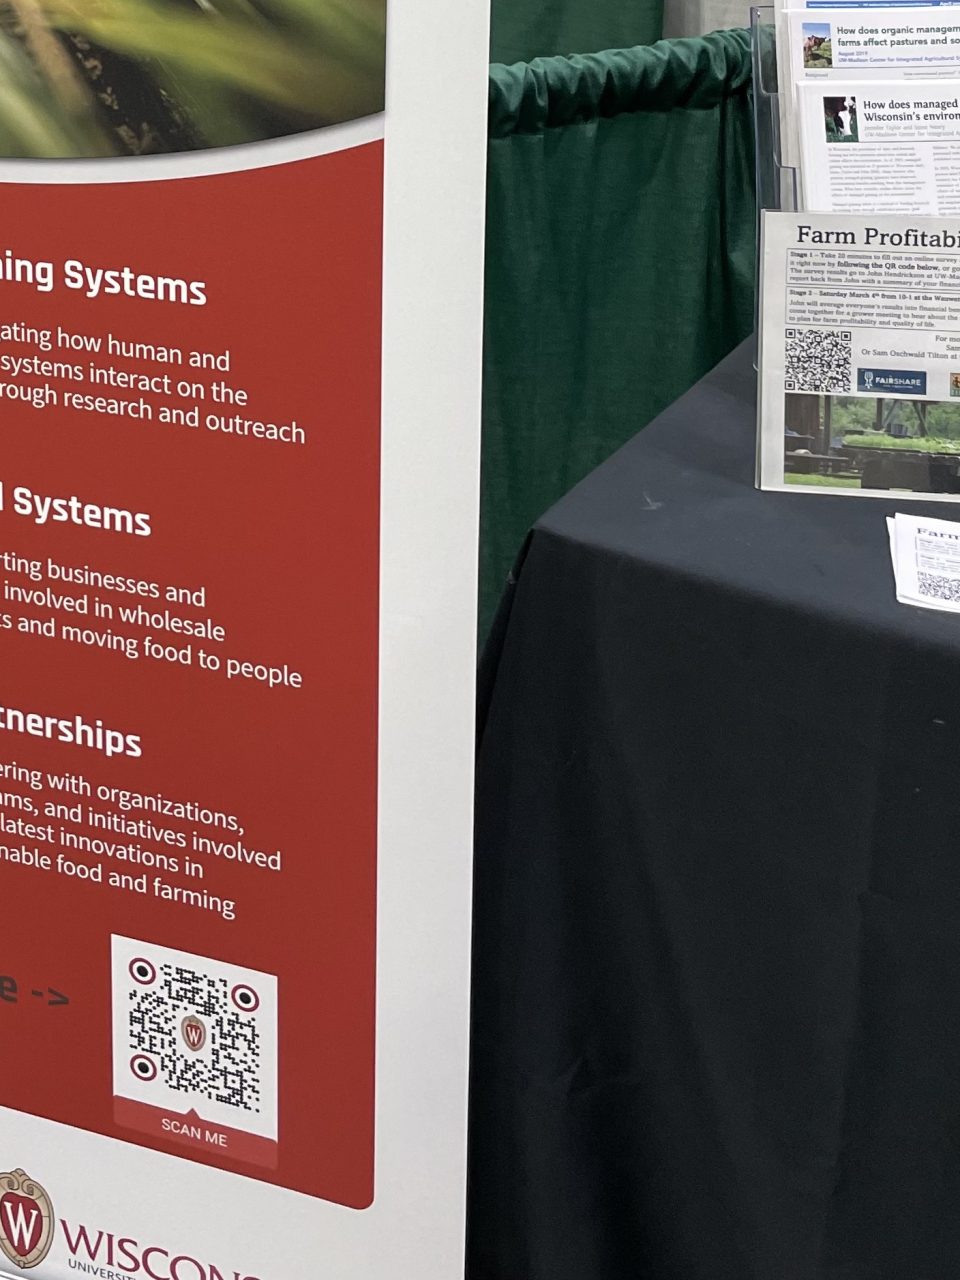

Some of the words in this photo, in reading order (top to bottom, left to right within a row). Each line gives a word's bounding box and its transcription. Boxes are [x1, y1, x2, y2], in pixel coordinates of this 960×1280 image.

[838, 38, 860, 46] farms
[863, 37, 887, 46] affect
[890, 38, 927, 47] pastures
[858, 26, 878, 34] does
[882, 26, 914, 35] organic
[864, 101, 885, 109] How
[889, 100, 910, 109] does
[914, 98, 958, 111] managed
[797, 226, 856, 244] Farm
[64, 260, 207, 305] Systems
[838, 261, 869, 269] following
[57, 327, 101, 353] how
[108, 334, 182, 364] human
[189, 350, 230, 371] and
[890, 350, 925, 358] Oschwald
[950, 352, 957, 360] at
[0, 352, 83, 381] systems
[90, 363, 171, 394] interact
[177, 382, 205, 400] on
[211, 381, 248, 405] the
[876, 377, 921, 386] FAIRSHARE
[64, 391, 152, 419] research
[159, 407, 199, 427] and
[206, 413, 305, 443] outreach
[13, 487, 151, 536] Systems
[47, 559, 159, 598] businesses
[166, 587, 205, 607] and
[4, 581, 88, 614] involved
[95, 597, 112, 618] in
[119, 605, 225, 641] wholesale
[18, 617, 55, 637] and
[62, 625, 138, 658] moving
[144, 637, 191, 665] food
[198, 651, 220, 671] to
[227, 657, 302, 688] people
[47, 773, 90, 796] with
[97, 786, 244, 834] organizations,
[1, 814, 54, 843] latest
[61, 827, 178, 872] innovations
[185, 856, 203, 878] in
[44, 799, 82, 822] and
[89, 807, 186, 847] initiatives
[193, 836, 281, 871] involved
[57, 854, 101, 883] food
[109, 870, 147, 893] and
[154, 878, 235, 920] farming
[187, 1026, 200, 1045] W
[161, 1118, 201, 1140] SCAN
[206, 1129, 227, 1146] ME
[4, 1201, 38, 1250] W
[60, 1219, 261, 1280] WISCO
